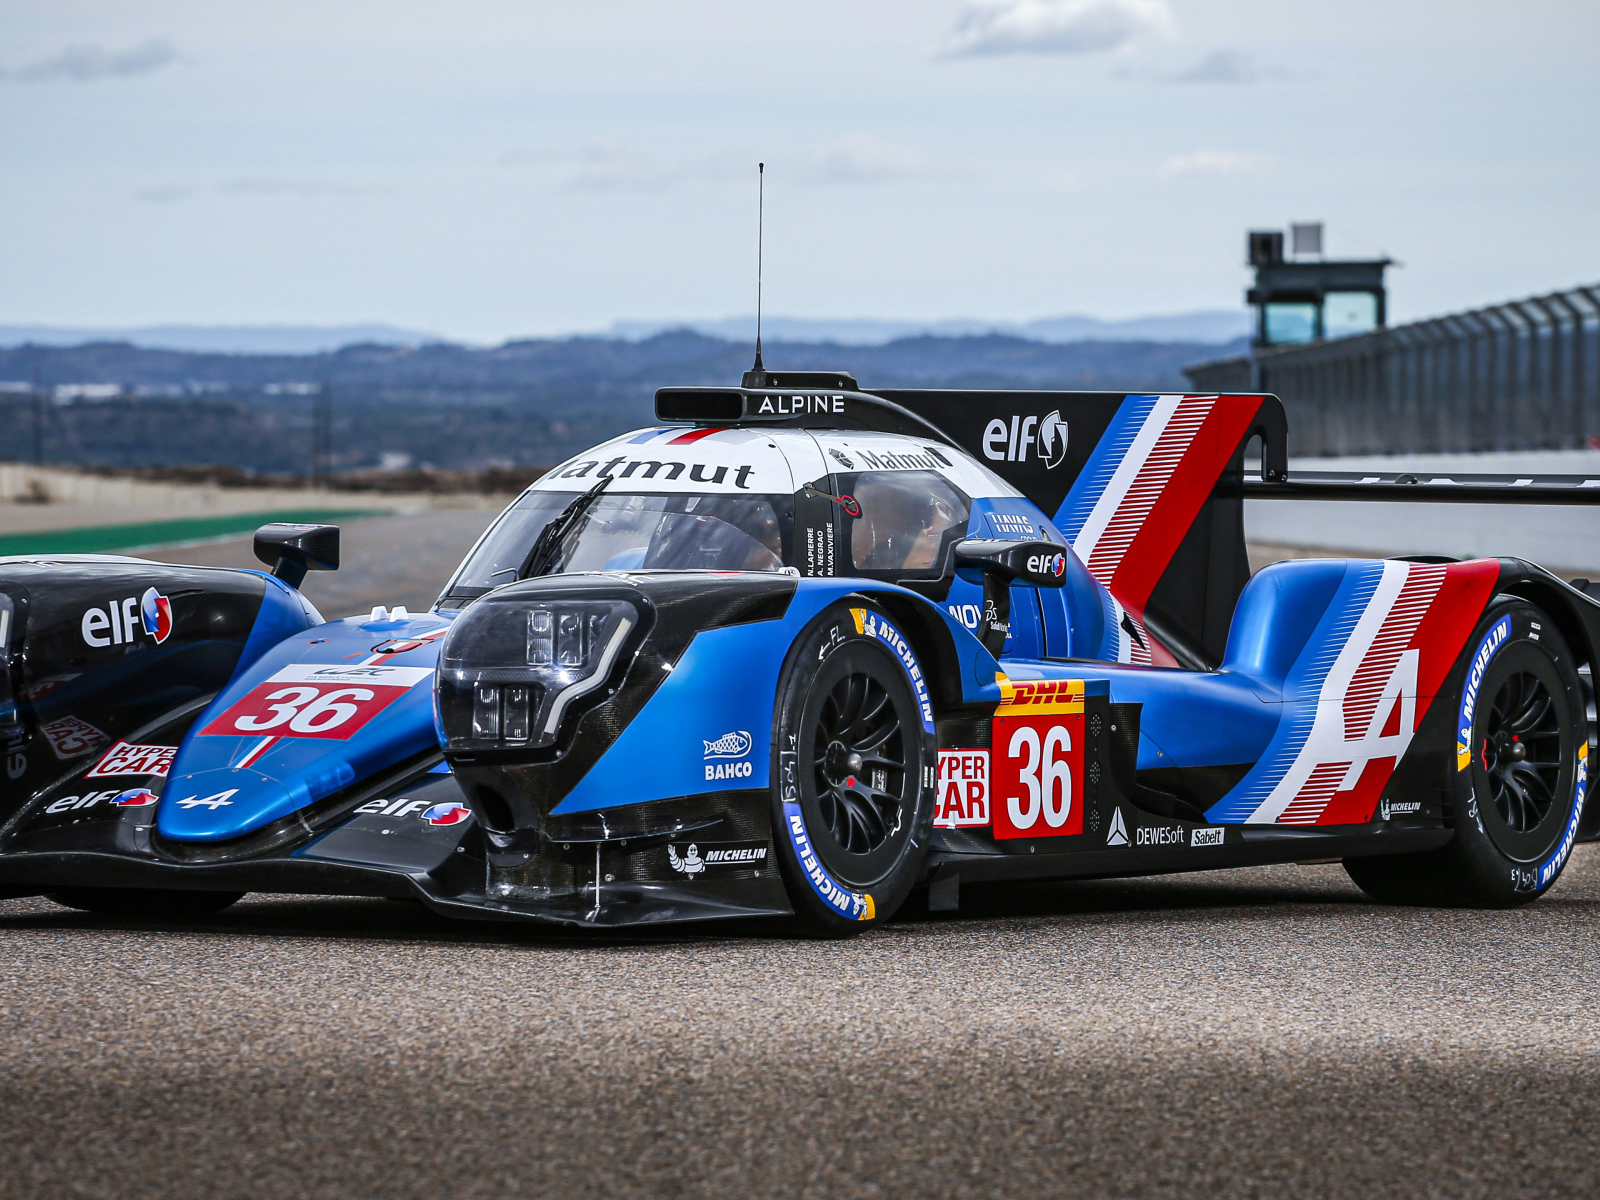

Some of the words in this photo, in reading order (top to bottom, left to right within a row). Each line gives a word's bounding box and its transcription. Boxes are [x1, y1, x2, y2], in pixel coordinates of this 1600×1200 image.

[758, 395, 845, 414] ALPINE
[982, 415, 1038, 462] elf
[855, 449, 944, 470] Matmut
[1027, 555, 1052, 573] elf
[81, 597, 139, 648] elf
[878, 621, 934, 722] MICHELIN
[1463, 621, 1507, 722] MICHELIN
[1011, 681, 1074, 705] DHL
[234, 686, 375, 733] 36
[113, 746, 178, 757] HYPE
[97, 757, 173, 774] CAR
[705, 761, 752, 780] BAHCO
[937, 756, 985, 780] YPER
[1006, 725, 1073, 830] 36
[46, 790, 121, 813] elf
[353, 798, 432, 817] elf
[1391, 802, 1421, 811] MICHELIN
[1136, 825, 1184, 845] DEWESoft
[1194, 829, 1221, 845] Sabelt
[1542, 787, 1585, 884] MICHELIN
[706, 848, 767, 861] MICHELIN
[790, 816, 851, 911] MICHELIN
